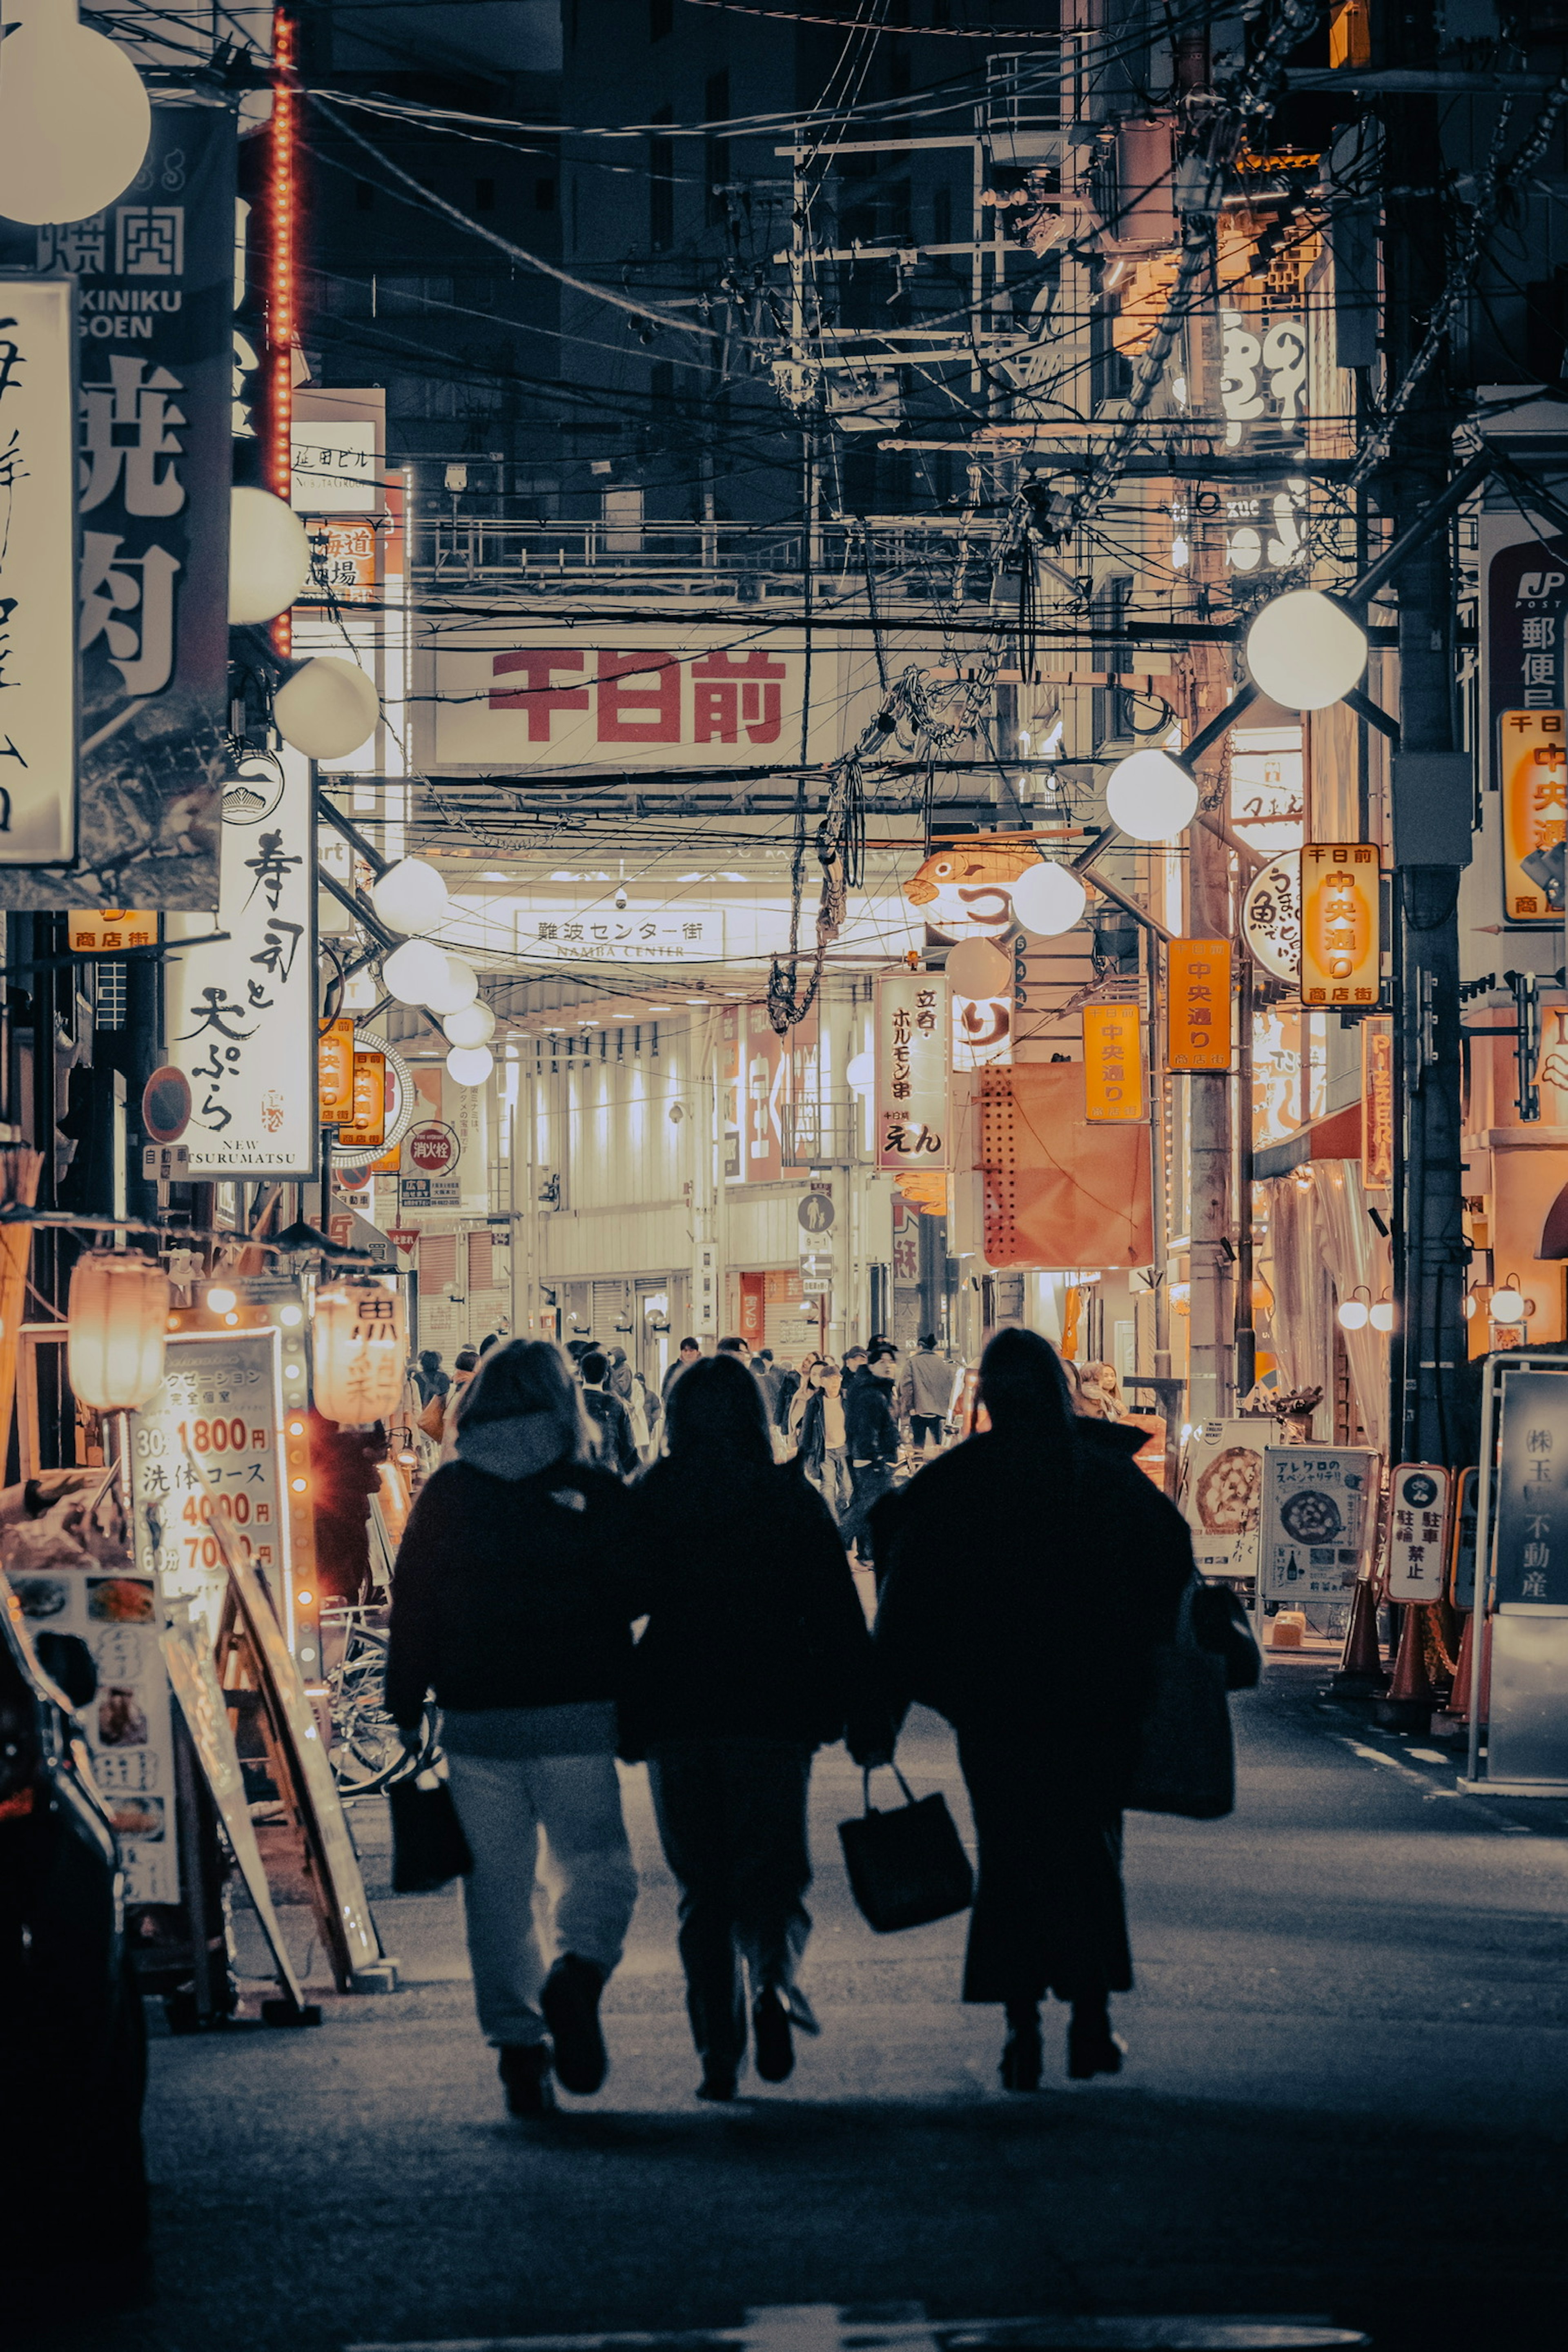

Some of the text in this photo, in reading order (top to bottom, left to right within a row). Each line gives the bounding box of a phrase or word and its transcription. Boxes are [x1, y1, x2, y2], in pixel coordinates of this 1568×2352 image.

[79, 290, 182, 312] KINIKU
[1515, 600, 1562, 609] POST
[489, 650, 786, 744] 千日前
[1510, 715, 1561, 733] 千日
[1309, 849, 1372, 863] 千日前
[242, 829, 304, 1009] 寿司と
[1325, 871, 1356, 979] 中央通り
[76, 931, 149, 947] 商店街
[537, 922, 703, 941] 難波センター街
[557, 946, 685, 957] NAMBA CENTER
[1174, 944, 1224, 955] 千日前
[1309, 987, 1372, 1001] 商店街
[1088, 1008, 1135, 1018] 千日前
[1187, 961, 1212, 1049] 中央通り
[173, 987, 260, 1133] 天ぷら
[893, 1009, 911, 1100] ホルモン串
[1100, 1024, 1125, 1102] 中央通り
[1174, 1054, 1225, 1065] 商店街
[1372, 1034, 1391, 1175] PIZZERIA
[223, 1140, 260, 1151] NEW
[884, 1125, 942, 1153] えん
[146, 1148, 187, 1164] 自動車
[188, 1153, 297, 1164] TSURUMATSU
[413, 1142, 449, 1158] 消火栓
[405, 1180, 426, 1190] 広告
[393, 1236, 414, 1245] 止まれ
[744, 1295, 757, 1327] 宝くじ
[163, 1370, 261, 1387] クゼーション
[170, 1391, 231, 1406] 完全個室
[1276, 1460, 1340, 1473] アレグロの
[143, 1462, 265, 1493] 洗体コース
[1396, 1510, 1414, 1543] 駐輪
[1421, 1512, 1441, 1544] 駐車
[1407, 1545, 1425, 1580] 禁止
